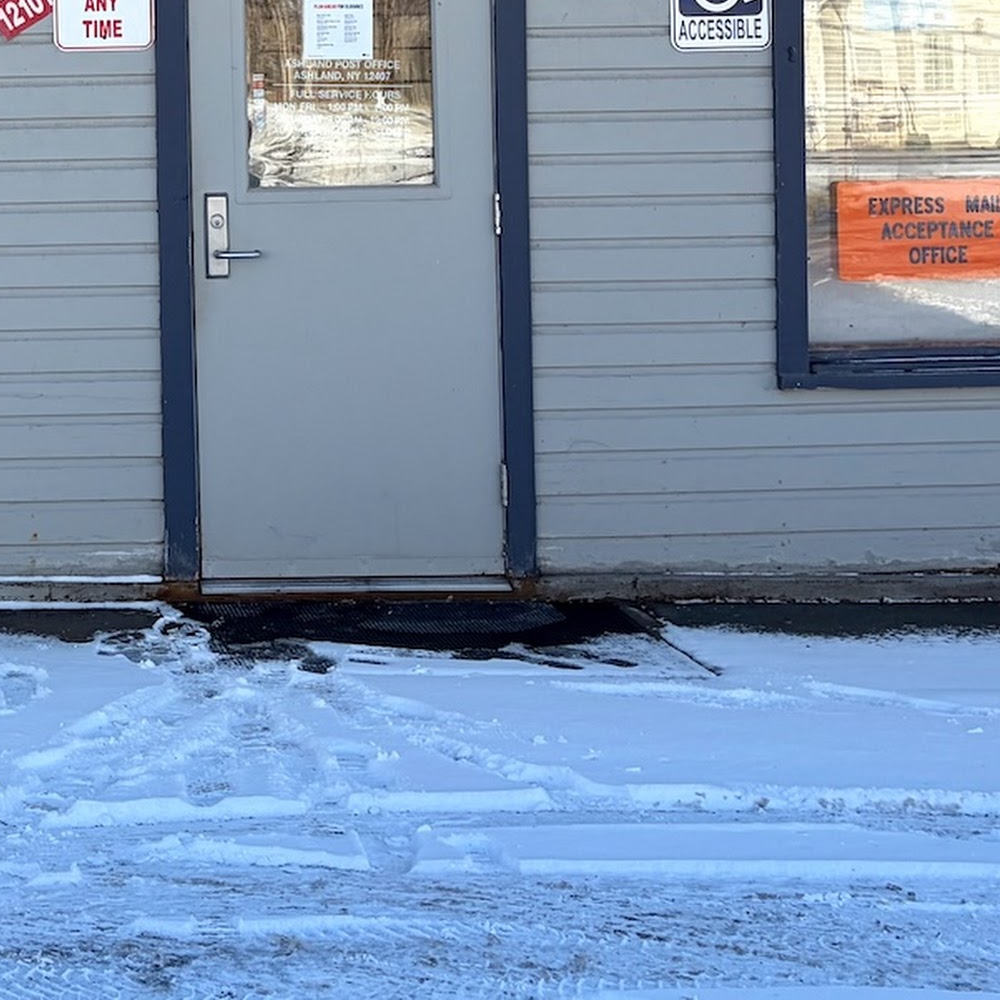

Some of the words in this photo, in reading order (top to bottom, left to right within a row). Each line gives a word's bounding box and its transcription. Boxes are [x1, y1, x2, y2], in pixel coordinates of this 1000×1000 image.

[82, 20, 123, 38] TIME
[678, 18, 763, 41] ACCESSIBLE
[285, 59, 333, 69] ASHAND
[335, 60, 361, 69] POST
[364, 60, 401, 70] OFFICE
[294, 71, 345, 81] ASHLAND,
[346, 71, 361, 81] NY
[318, 90, 362, 100] SERVICE
[867, 197, 945, 215] EXPRESS
[881, 220, 995, 240] ACCEPTANCE
[908, 245, 968, 264] OFFICE
